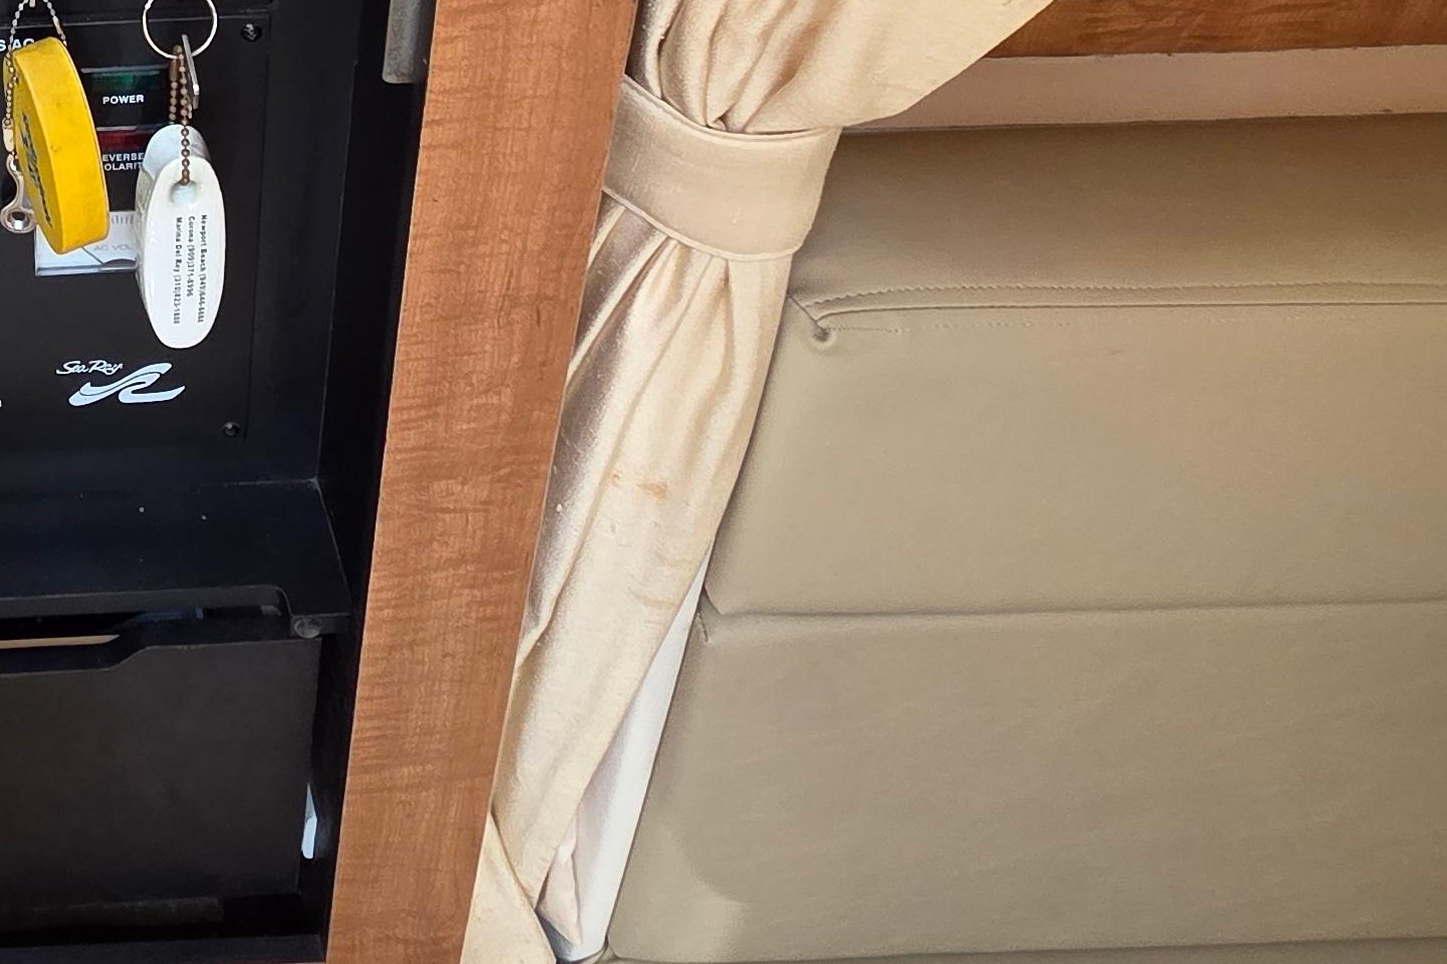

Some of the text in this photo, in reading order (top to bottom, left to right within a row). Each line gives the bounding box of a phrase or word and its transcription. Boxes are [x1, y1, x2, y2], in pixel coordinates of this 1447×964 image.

[103, 95, 144, 104] POWER
[102, 152, 144, 162] EVERSE
[173, 259, 182, 273] Rey
[57, 360, 123, 375] Sea Ray
